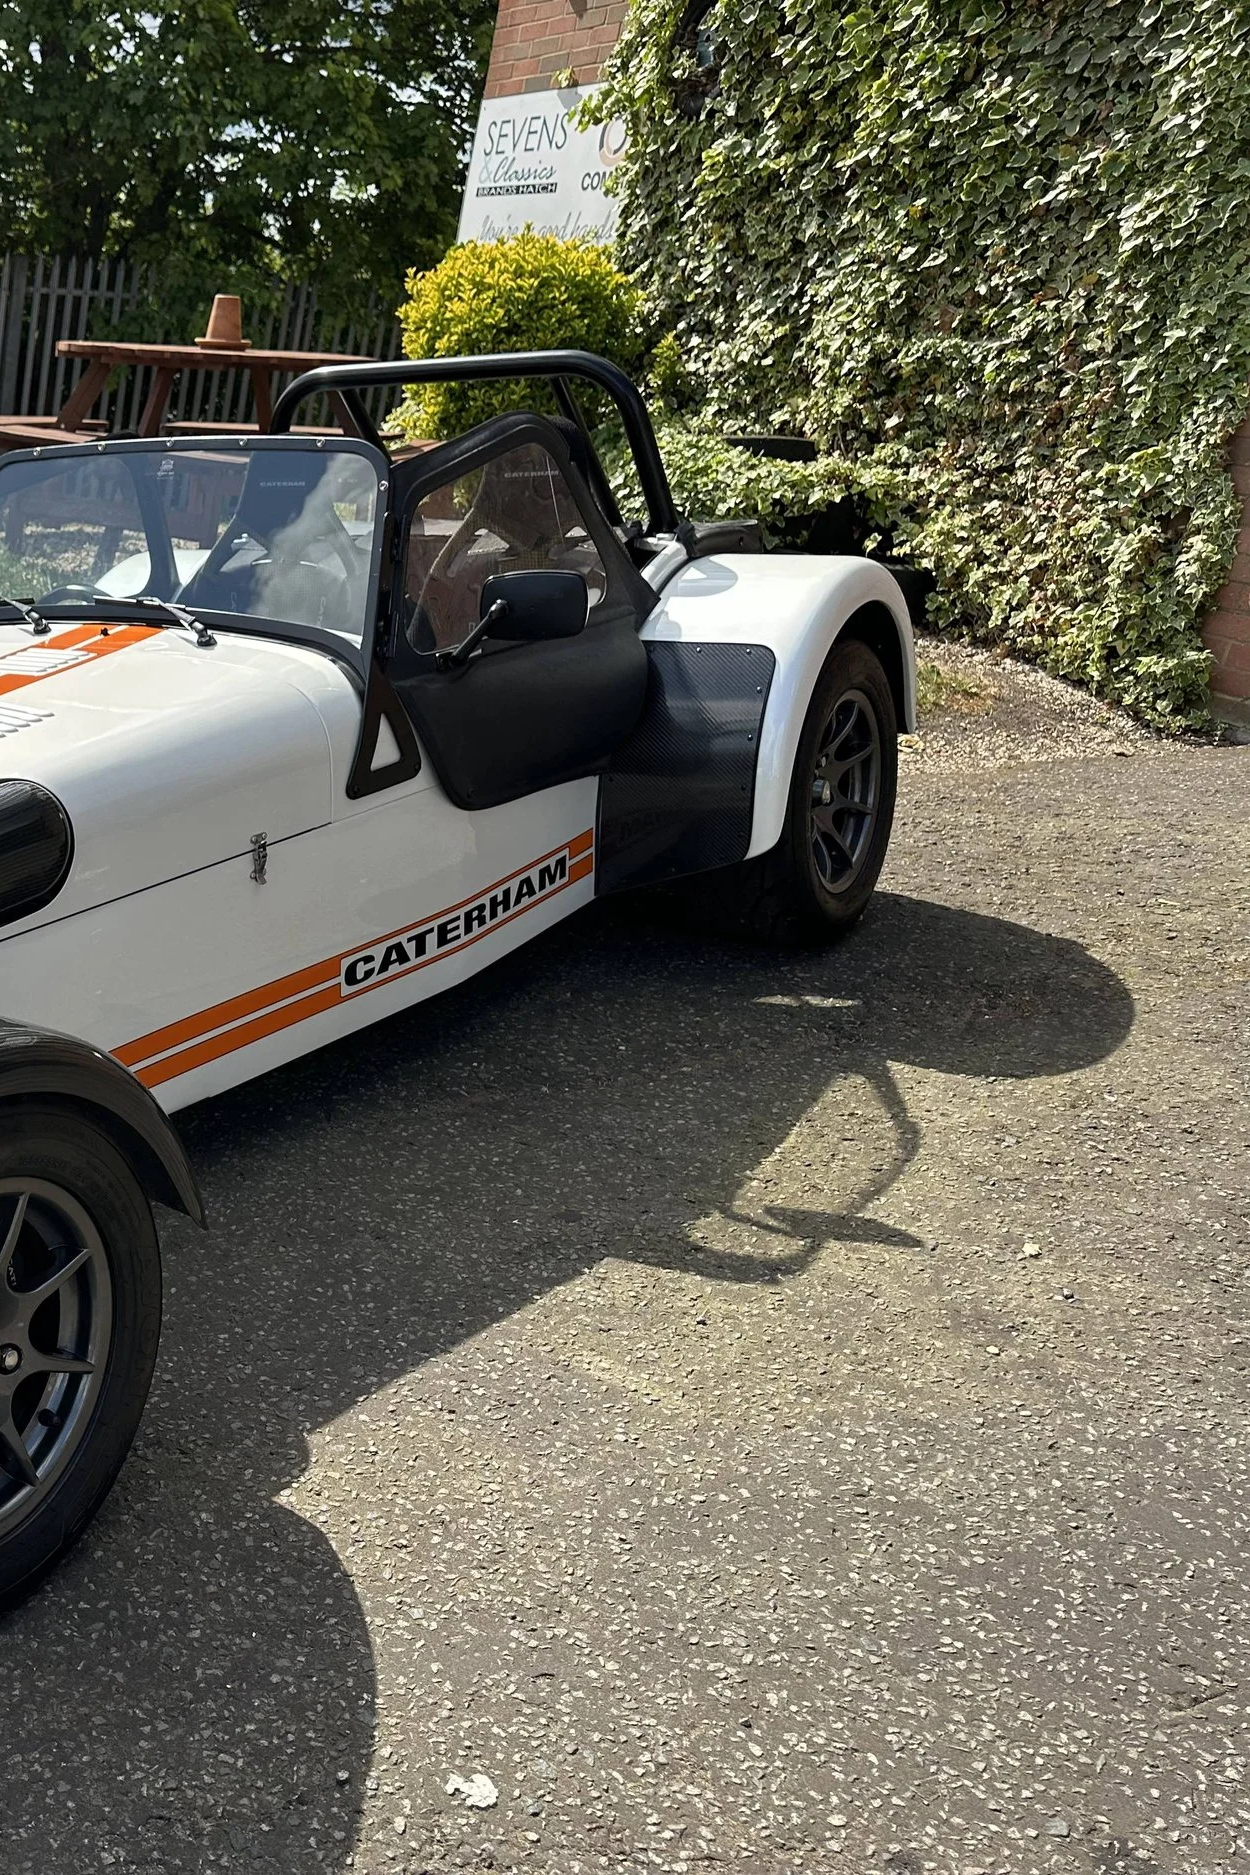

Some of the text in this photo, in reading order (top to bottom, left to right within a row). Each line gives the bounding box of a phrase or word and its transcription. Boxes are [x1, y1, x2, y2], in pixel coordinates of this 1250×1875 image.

[483, 112, 569, 156] SEVENS
[477, 183, 557, 197] BRANDS HATCH
[344, 854, 567, 987] CATERHAM
